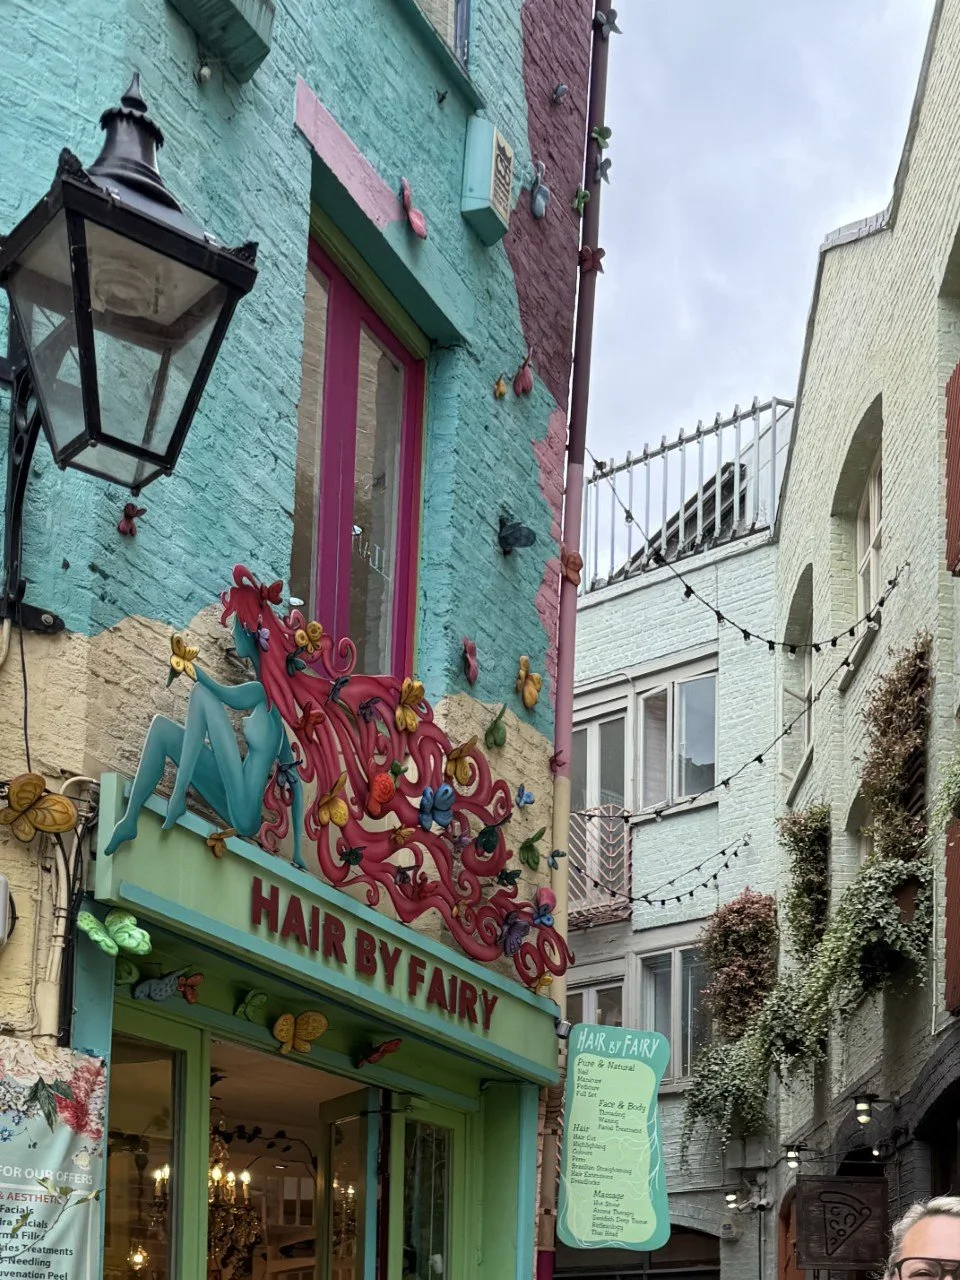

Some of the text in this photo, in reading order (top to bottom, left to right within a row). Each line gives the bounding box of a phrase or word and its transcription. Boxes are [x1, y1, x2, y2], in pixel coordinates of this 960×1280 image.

[251, 876, 498, 1031] HAIR BY FAIRY
[577, 1028, 660, 1058] HAIR BY FAIRY
[577, 1058, 635, 1071] Pure & Natural
[598, 1099, 646, 1114] Face & Body
[573, 1124, 590, 1133] Hair
[25, 1168, 54, 1180] OUR
[56, 1171, 93, 1185] OFFERS
[593, 1190, 624, 1201] Massage
[0, 1204, 34, 1214] Facials
[48, 1271, 68, 1280] Peel
